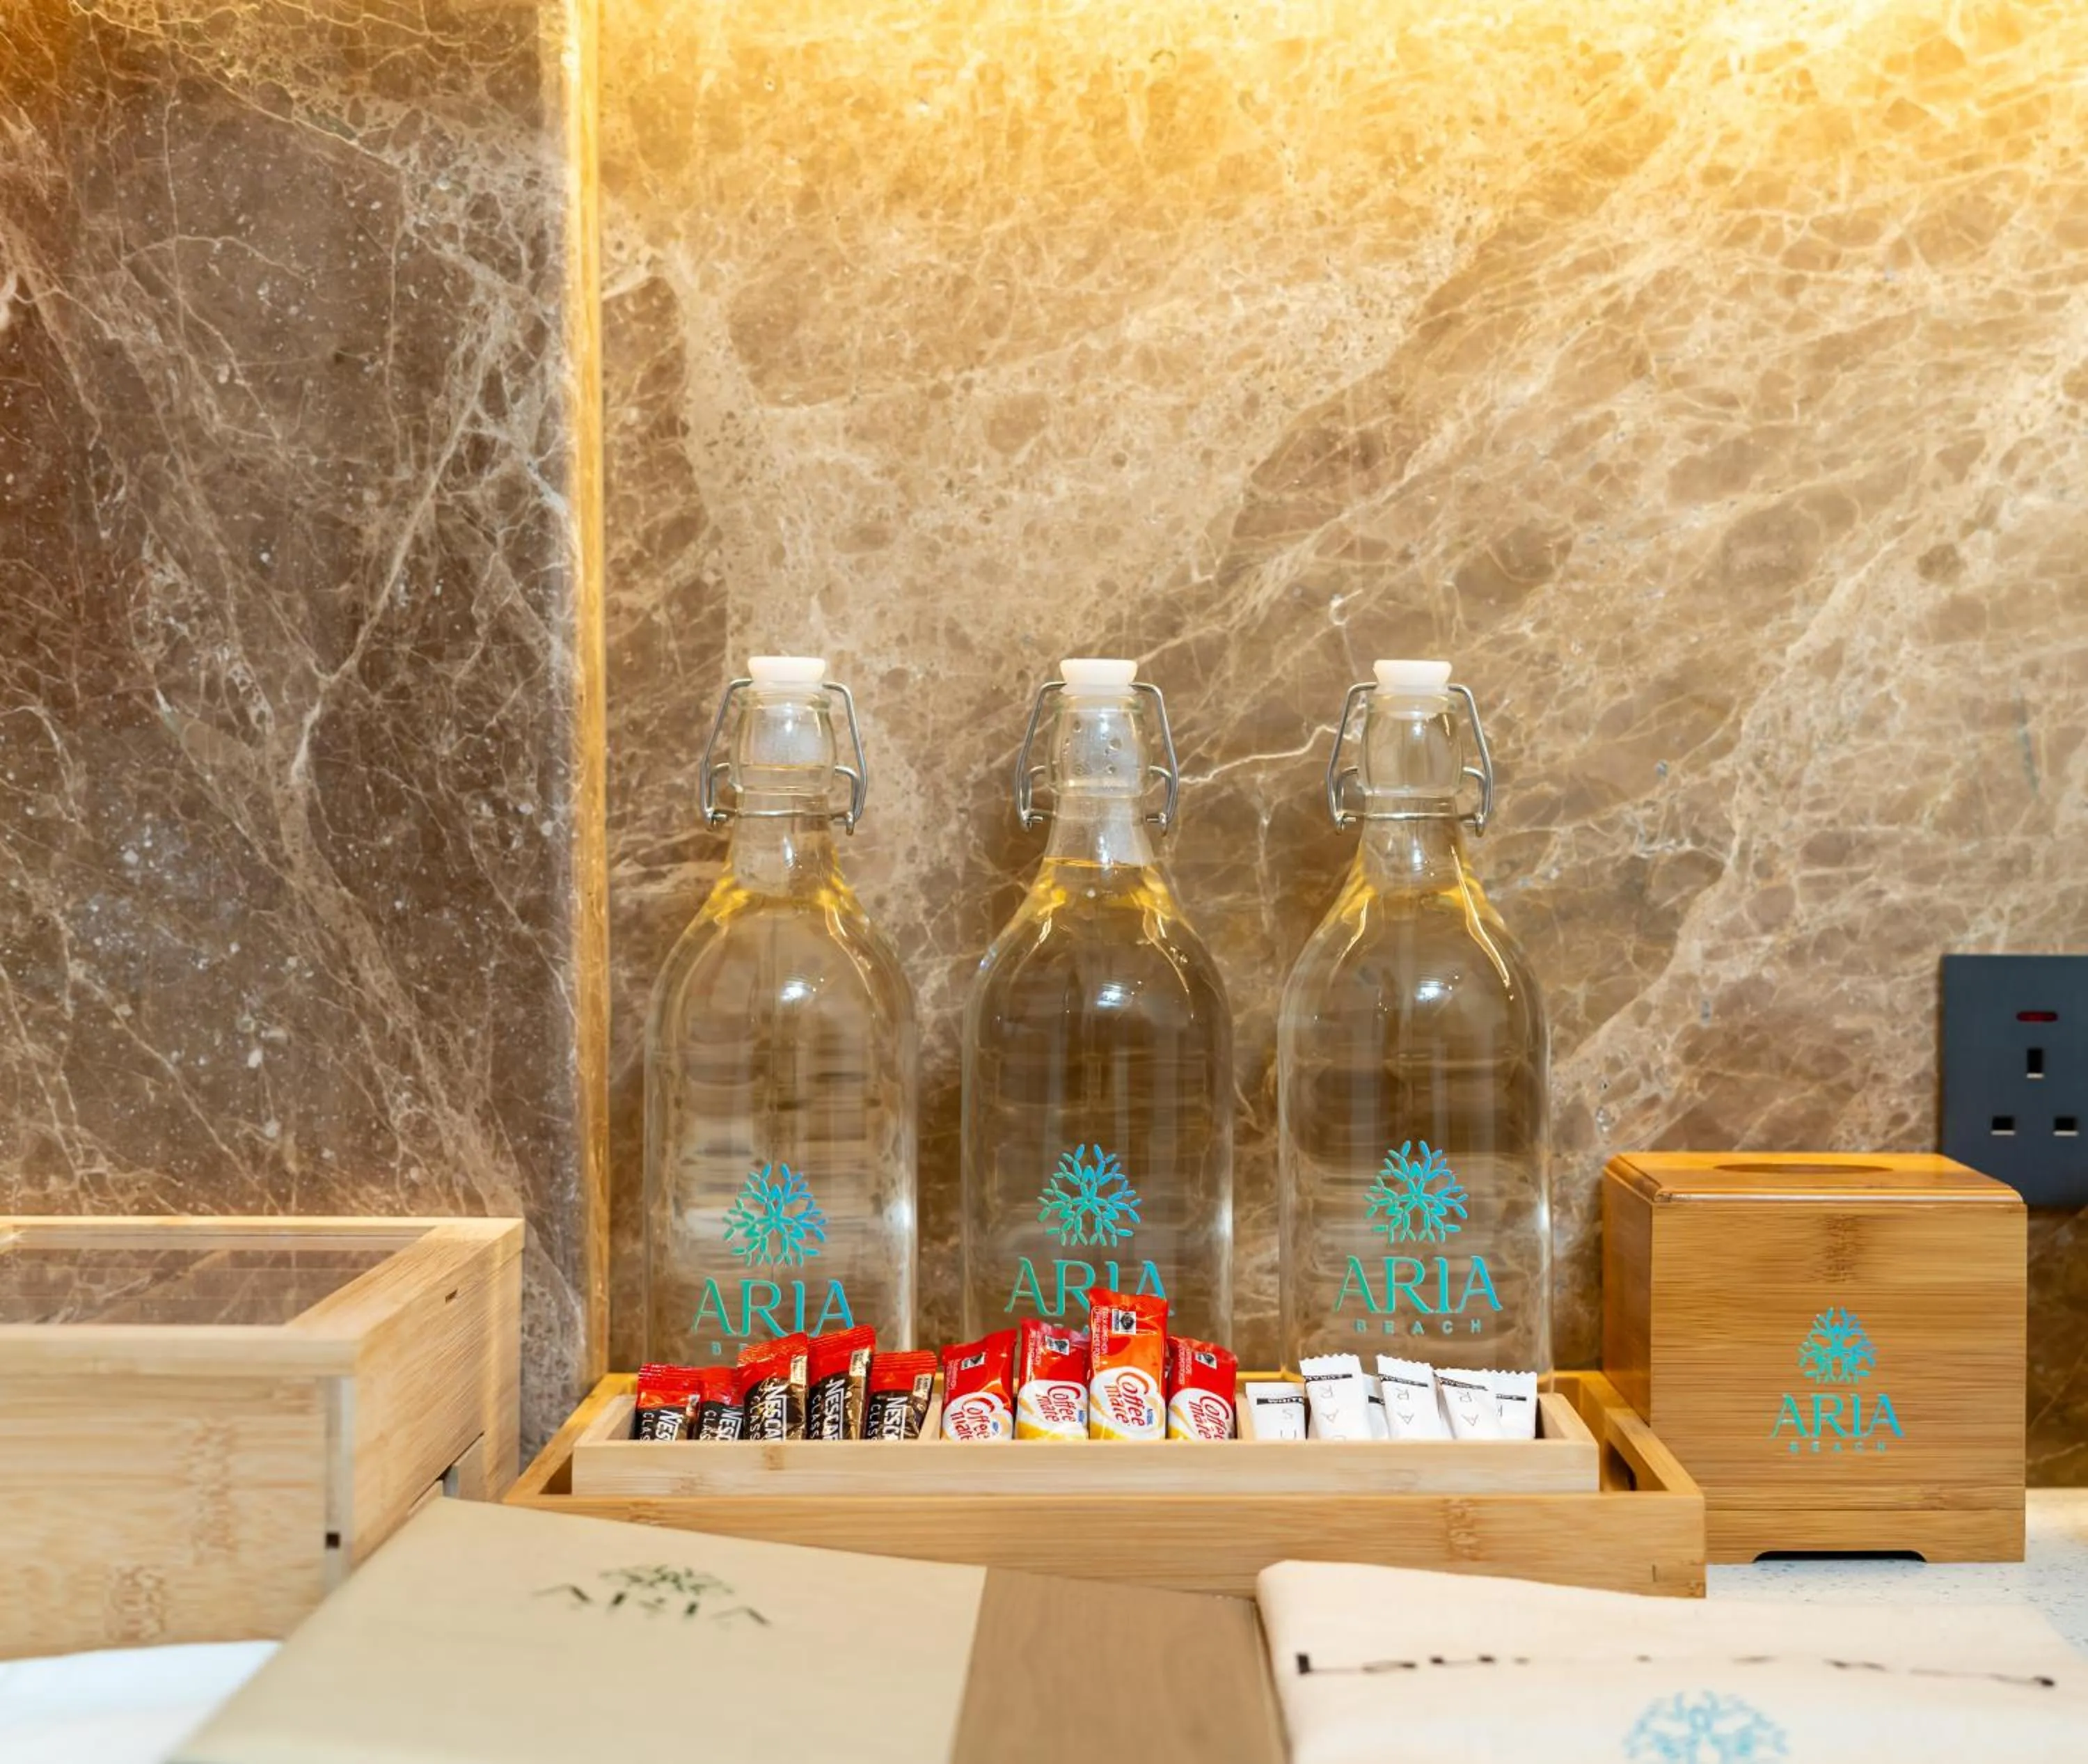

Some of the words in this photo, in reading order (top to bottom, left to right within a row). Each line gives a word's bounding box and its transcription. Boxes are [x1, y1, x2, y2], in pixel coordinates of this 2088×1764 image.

[1004, 1256, 1168, 1316] ARIA
[1334, 1254, 1503, 1314] ARIA
[690, 1277, 855, 1337] ARIA
[1354, 1318, 1482, 1335] BEACH
[750, 1396, 761, 1440] CLASS
[764, 1384, 789, 1440] NESCA
[810, 1394, 822, 1439] CLASS
[1036, 1394, 1060, 1422] mate
[1047, 1385, 1082, 1422] Coffee
[1105, 1385, 1129, 1424] mate
[1116, 1371, 1149, 1426] Coffee
[1771, 1393, 1905, 1438] ARIA
[640, 1412, 655, 1440] CLAS
